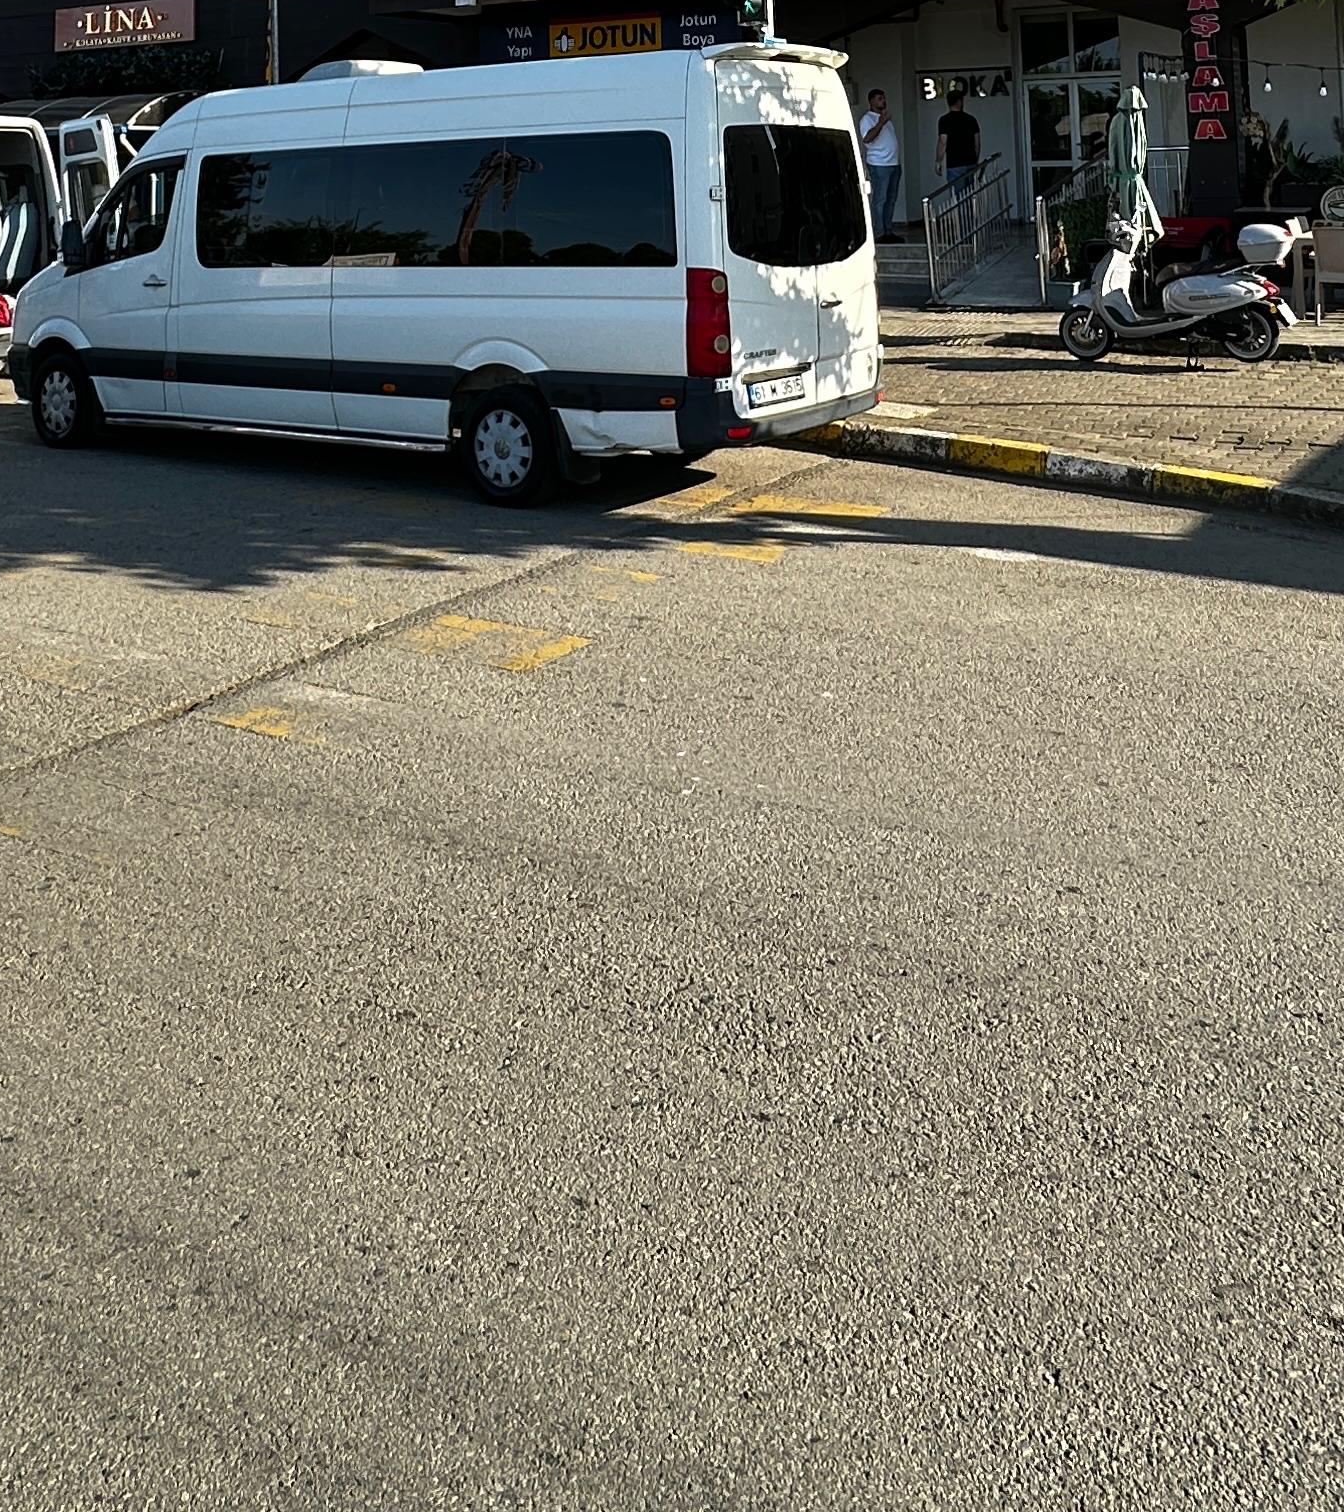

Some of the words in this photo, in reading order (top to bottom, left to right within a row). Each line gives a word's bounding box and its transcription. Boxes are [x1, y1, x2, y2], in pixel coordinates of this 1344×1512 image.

[85, 5, 154, 35] LİNA
[679, 14, 717, 27] Jotun
[506, 26, 533, 38] YNA
[578, 23, 656, 50] JOTUN
[682, 33, 715, 49] Boya
[507, 45, 532, 59] Yapı
